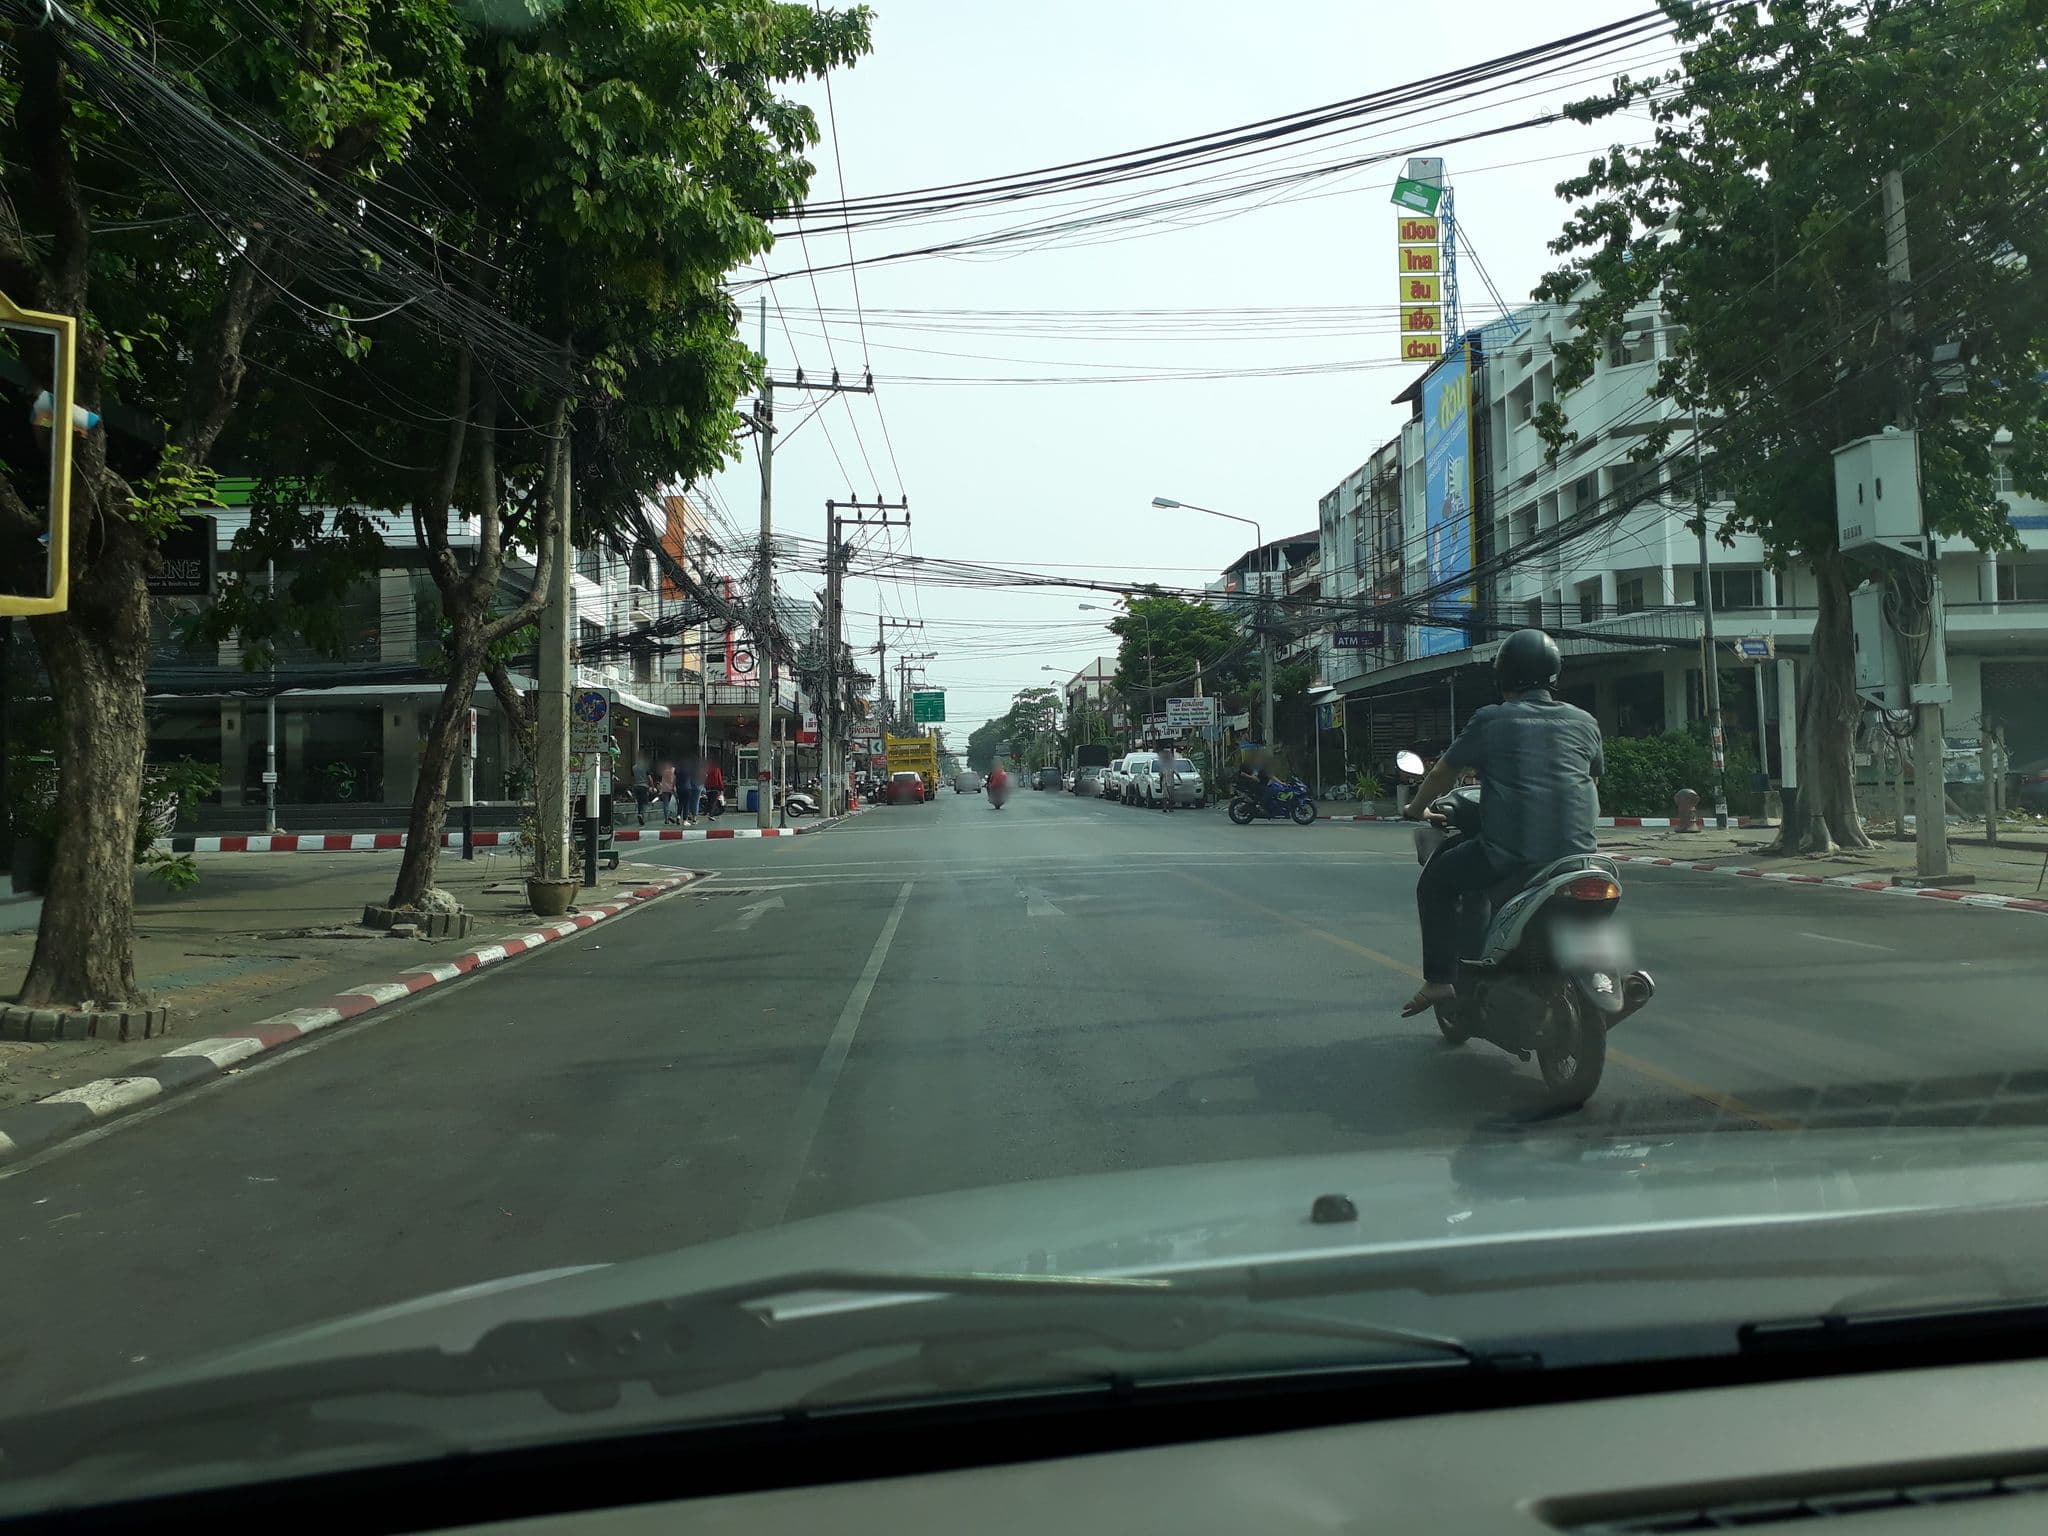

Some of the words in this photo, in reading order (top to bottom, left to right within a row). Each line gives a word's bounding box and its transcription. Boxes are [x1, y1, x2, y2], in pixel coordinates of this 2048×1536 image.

[1404, 249, 1432, 270] ไทย
[1407, 340, 1437, 358] ด่วน
[1338, 637, 1358, 646] ATM
